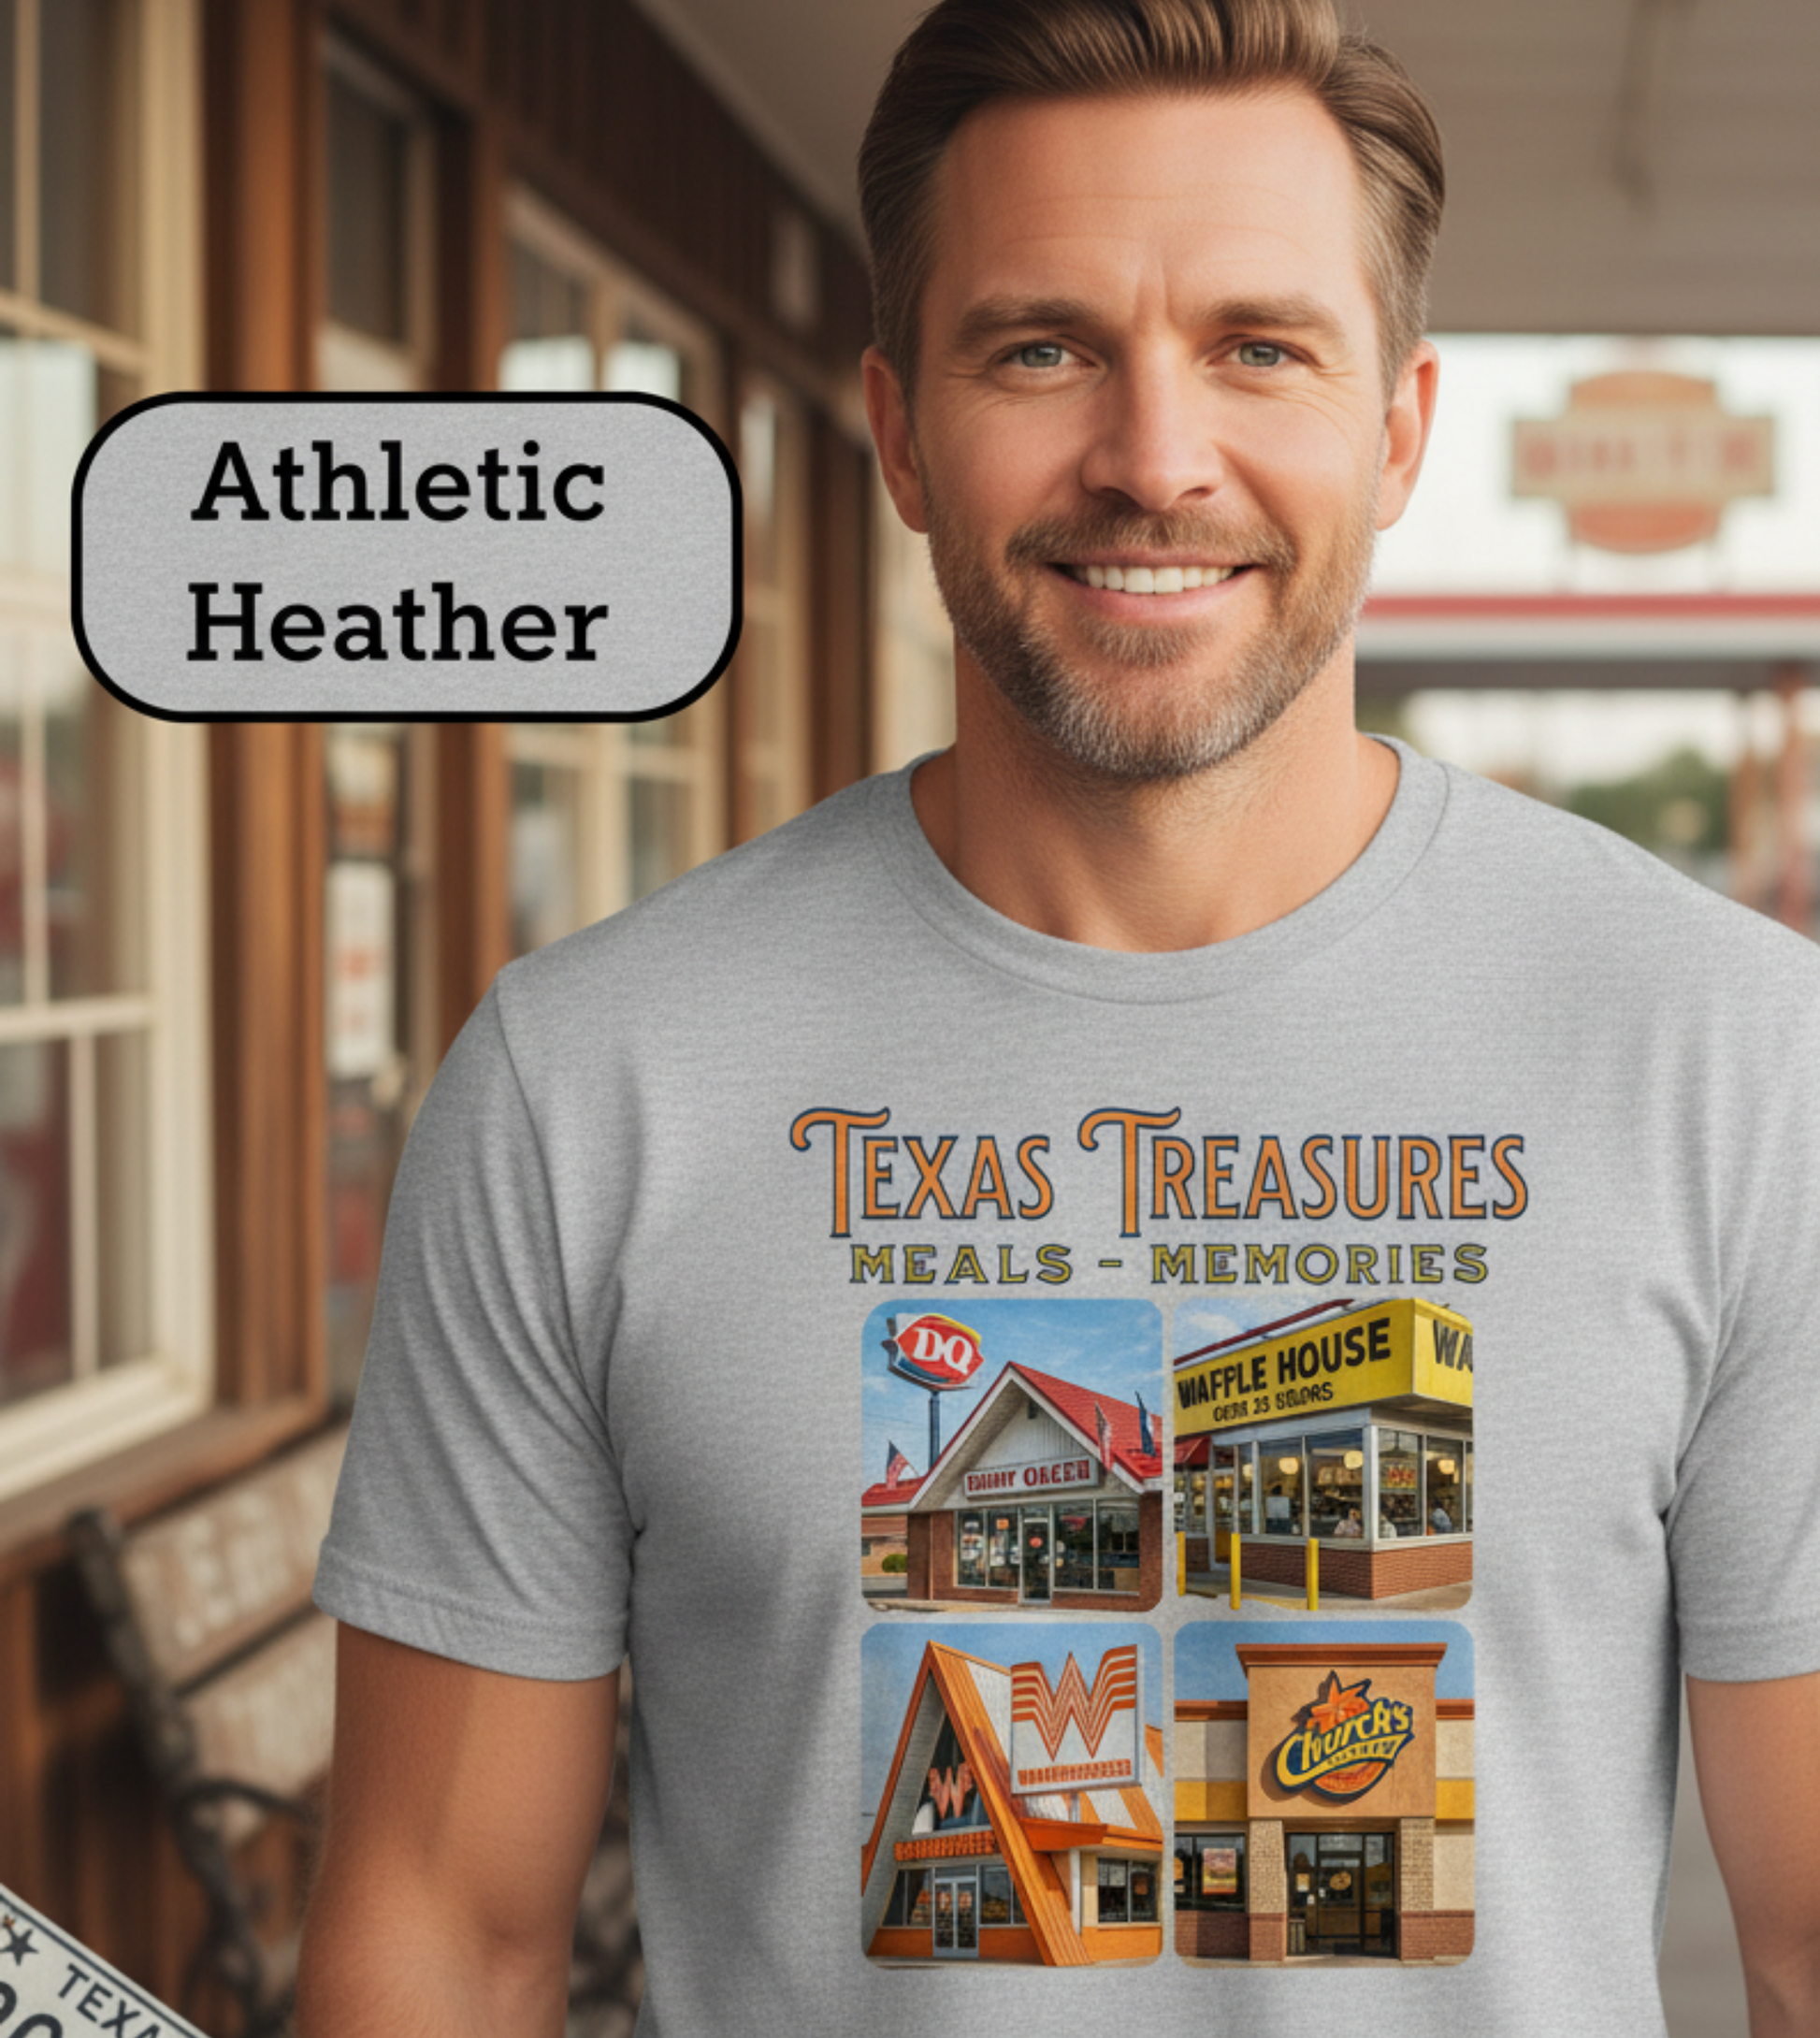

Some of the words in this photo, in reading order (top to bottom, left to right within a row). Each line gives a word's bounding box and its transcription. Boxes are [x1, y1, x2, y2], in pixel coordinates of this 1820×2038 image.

[789, 1106, 1055, 1238] TEXAS
[1076, 1106, 1529, 1238] TREASURES
[849, 1244, 1074, 1285] MEALS
[1150, 1244, 1489, 1285] MEMORIES
[912, 1326, 974, 1376] DQ
[1278, 1317, 1392, 1385] HOUSE
